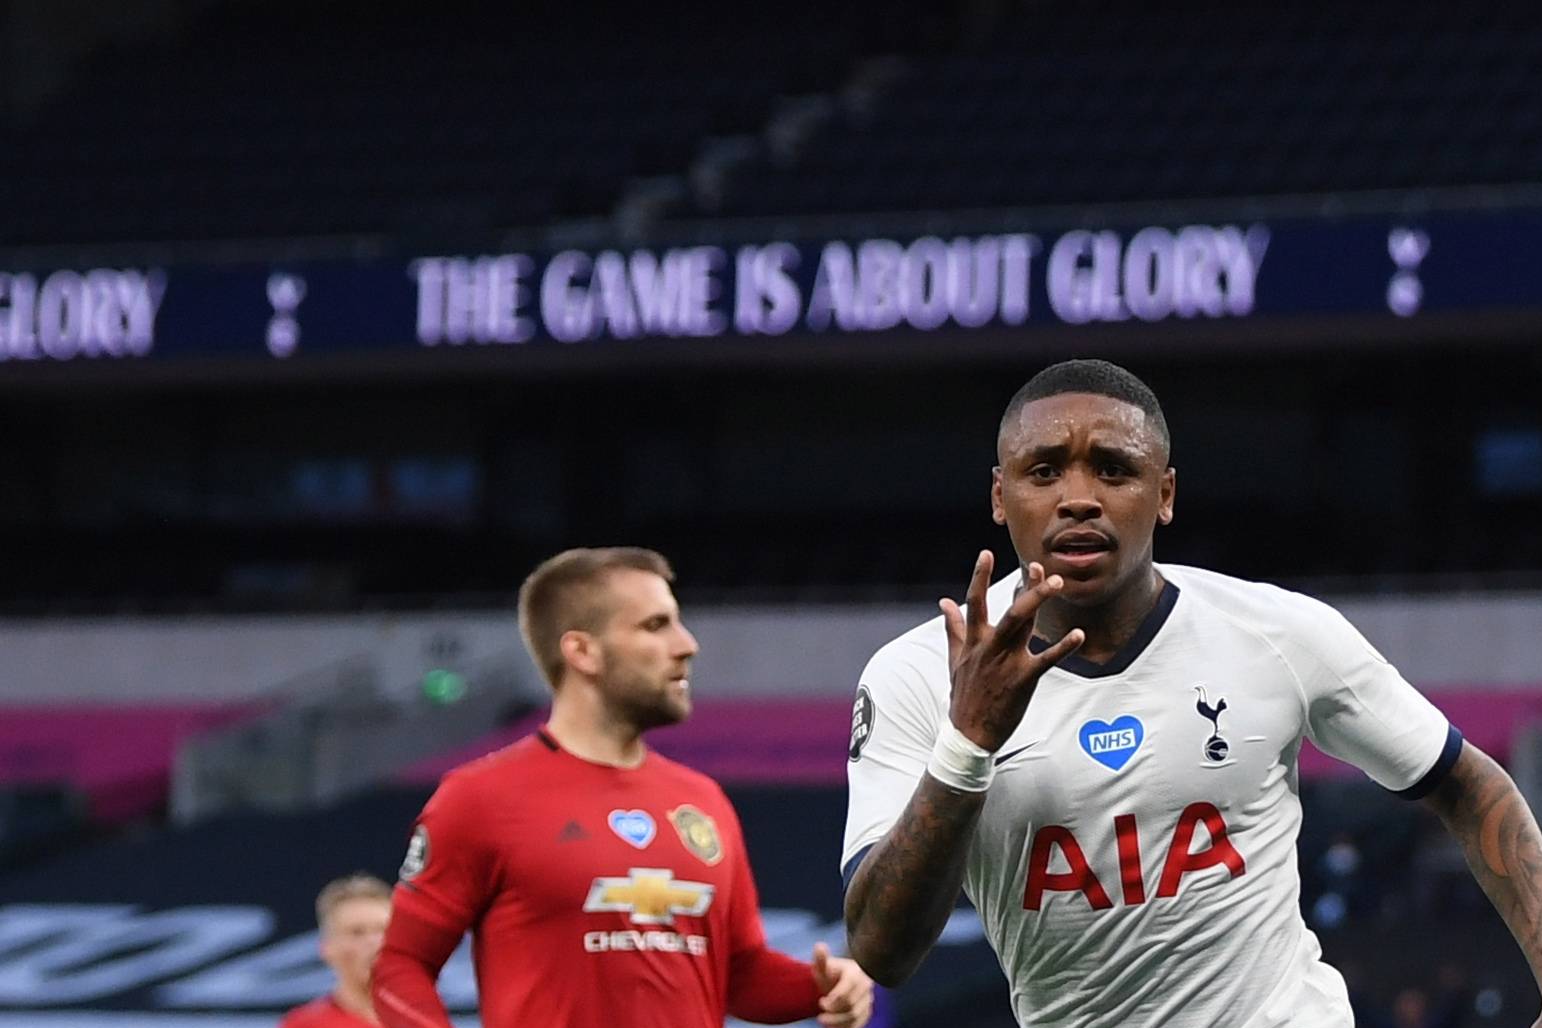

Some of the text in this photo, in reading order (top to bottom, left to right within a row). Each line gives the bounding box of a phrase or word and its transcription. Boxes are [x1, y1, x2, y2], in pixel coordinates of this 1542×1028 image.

[409, 223, 1270, 346] THE GAME IS ABOUT GLORY
[1092, 730, 1133, 752] NHS
[1022, 801, 1247, 912] AIA
